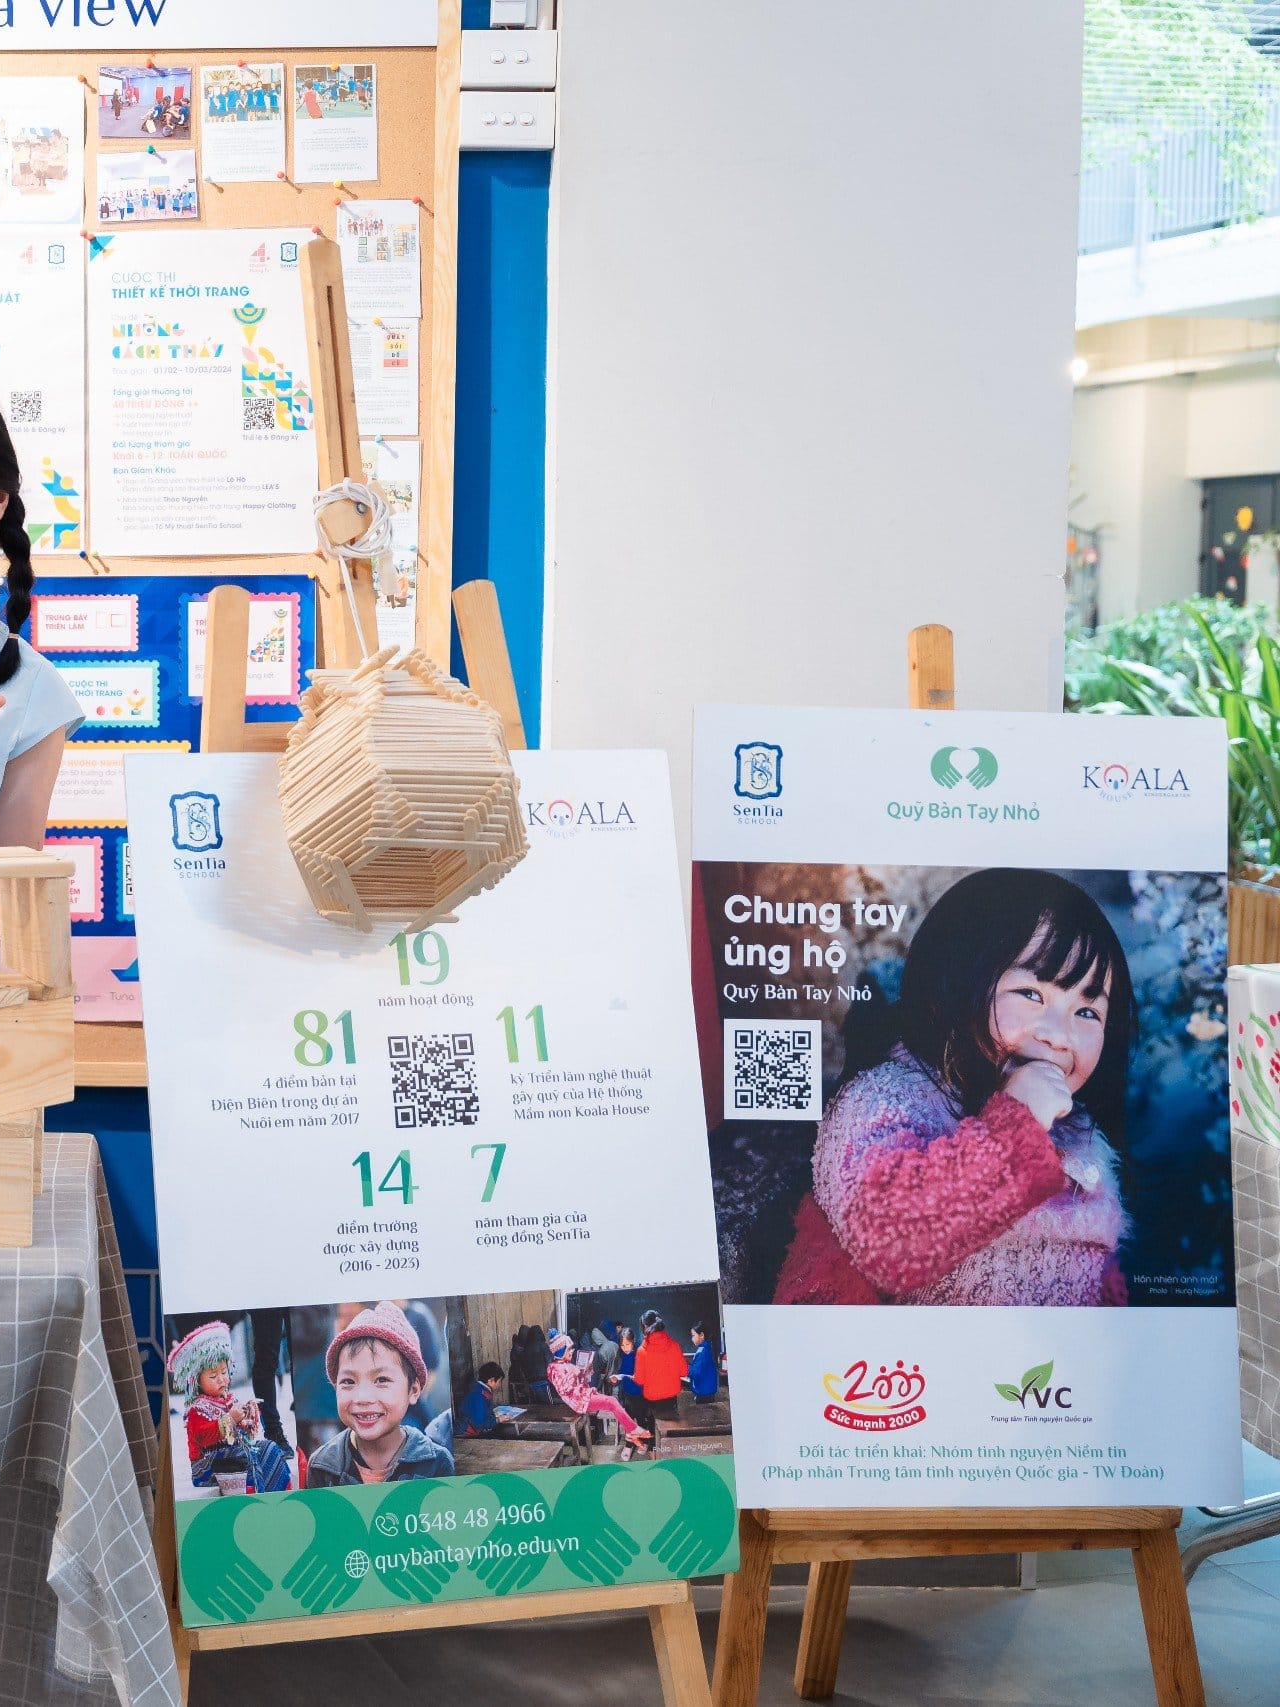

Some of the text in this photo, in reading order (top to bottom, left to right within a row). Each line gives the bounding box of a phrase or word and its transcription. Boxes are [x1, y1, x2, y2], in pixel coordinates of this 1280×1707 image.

[204, 286, 250, 297] TRANG
[95, 689, 123, 697] TRANG
[96, 680, 108, 688] THI
[733, 803, 783, 818] SenTia
[887, 800, 1040, 824] Quỹ Bàn Tay Nhỏ
[737, 817, 778, 825] SCHOOL
[173, 857, 226, 870] SenTia
[179, 871, 222, 879] SCHOOL
[724, 894, 908, 933] Chung tay
[388, 930, 450, 986] 19
[724, 935, 847, 975] ủng hộ
[378, 993, 474, 1008] năm hoạt động
[723, 983, 872, 1004] Quỹ Bàn Tay Nhỏ
[292, 1009, 358, 1067] 81
[495, 1004, 550, 1064] 11
[262, 1076, 271, 1089] 4
[275, 1073, 308, 1089] điểm
[340, 1073, 357, 1089] tại
[527, 1069, 561, 1084] Triển
[563, 1070, 585, 1082] lãm
[588, 1069, 618, 1084] nghệ
[621, 1067, 652, 1082] thuật
[247, 1096, 278, 1110] Biên
[281, 1096, 319, 1110] trong
[321, 1094, 340, 1109] dự
[512, 1084, 643, 1105] gây quỹ của Hệ thống
[239, 1112, 360, 1130] Nuôi em năm 2017
[514, 1104, 650, 1120] Mầm non Koala House
[351, 1149, 420, 1208] 14
[469, 1142, 508, 1204] 7
[336, 1219, 418, 1235] điểm trường
[475, 1210, 588, 1229] năm tham gia của
[476, 1228, 591, 1247] cộng đồng SenTia
[323, 1239, 420, 1257] được xây dựng
[339, 1259, 373, 1275] (2016
[384, 1257, 421, 1272] 2023)
[829, 1407, 921, 1431] Sức mạnh 2000
[990, 1415, 1009, 1424] Trung
[1039, 1415, 1063, 1424] nguyện
[1064, 1414, 1082, 1424] Quốc
[1083, 1415, 1093, 1424] gia
[799, 1442, 1127, 1462] Đối tác triển khai: Nhóm tình nguyện Niềm tin
[761, 1465, 804, 1482] (Pháp
[808, 1465, 843, 1479] nhân
[847, 1465, 891, 1482] Trung
[895, 1465, 922, 1479] tâm
[926, 1465, 954, 1479] tình
[959, 1465, 1012, 1482] nguyện
[1015, 1464, 1053, 1481] Quốc
[1058, 1465, 1079, 1482] gia
[1093, 1465, 1117, 1479] TW
[1120, 1464, 1165, 1481] Đoàn)
[404, 1502, 546, 1535] 0348 48 4966
[374, 1535, 580, 1575] quybantaynho.edu.vn
